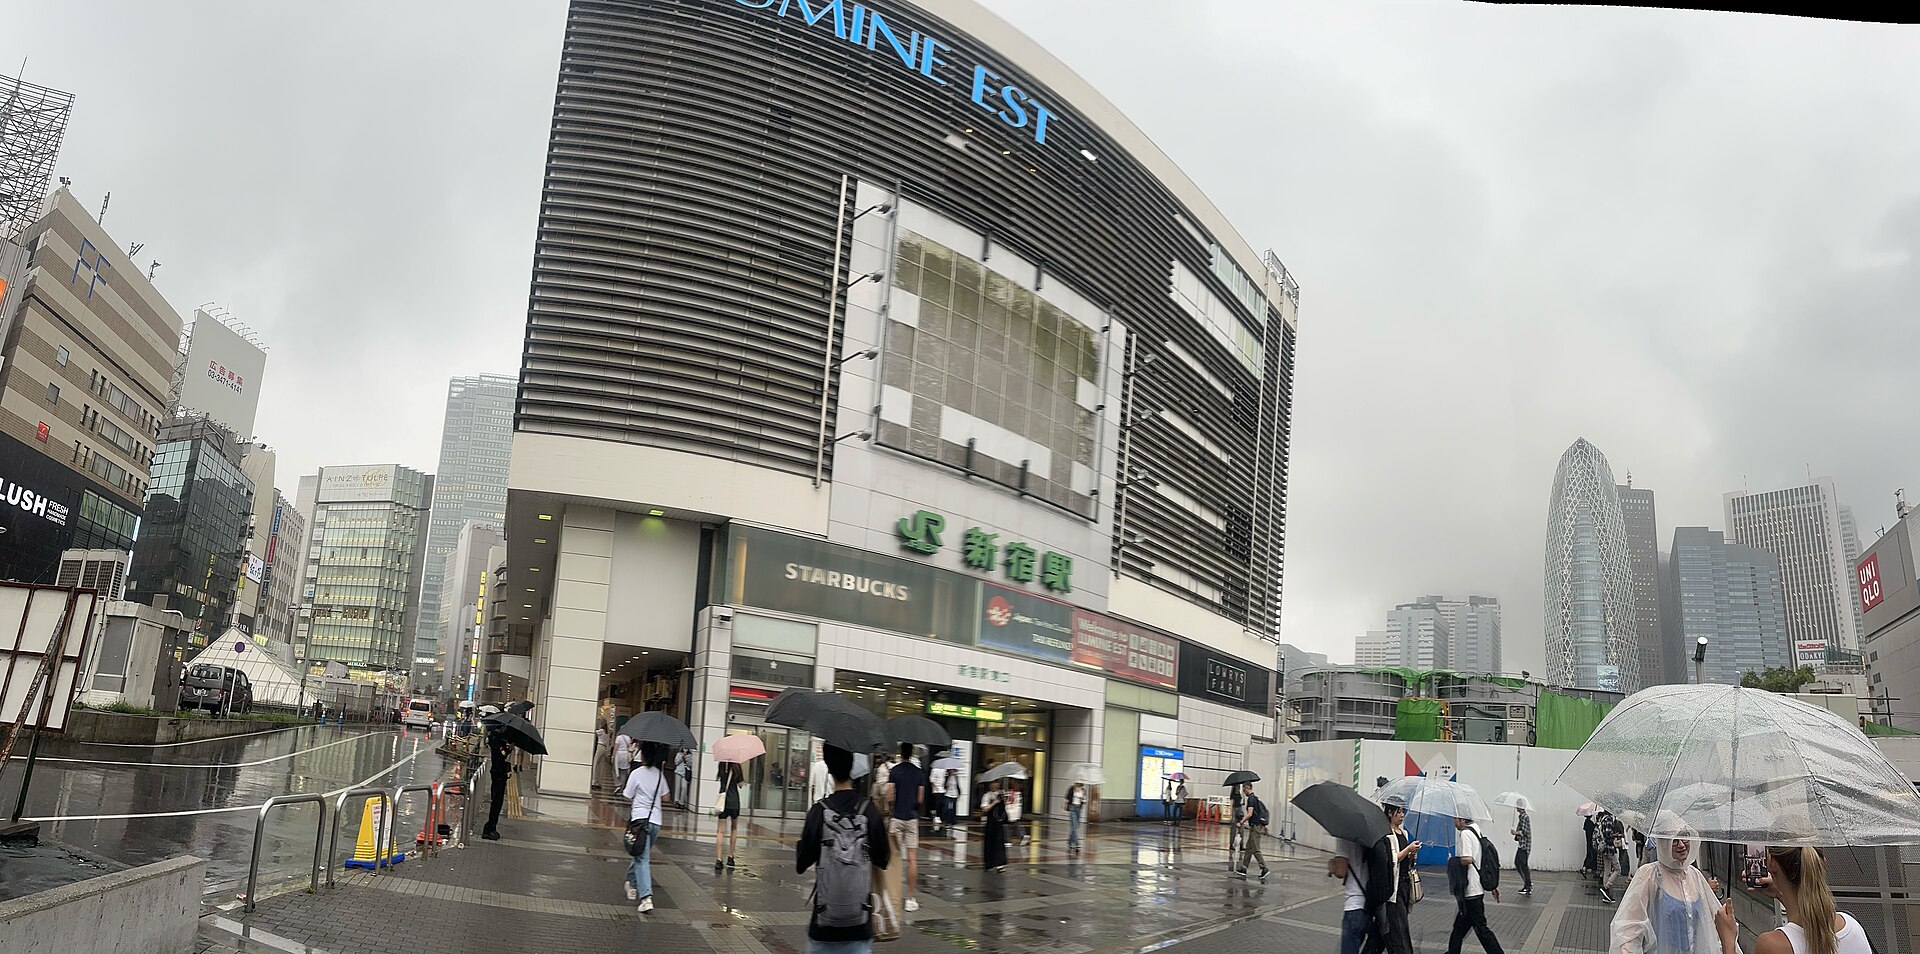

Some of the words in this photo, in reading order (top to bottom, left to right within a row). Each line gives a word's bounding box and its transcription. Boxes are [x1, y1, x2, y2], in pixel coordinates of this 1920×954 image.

[970, 64, 1059, 145] EST
[0, 477, 48, 517] LUSH
[49, 500, 69, 516] FRESH
[899, 510, 945, 547] JR
[965, 526, 1073, 594] 新宿駅
[784, 562, 908, 601] STARBUCKS
[1860, 561, 1876, 584] UNI
[1863, 580, 1880, 606] QLO
[1209, 663, 1244, 684] LOWRYS
[1211, 678, 1241, 696] FARM
